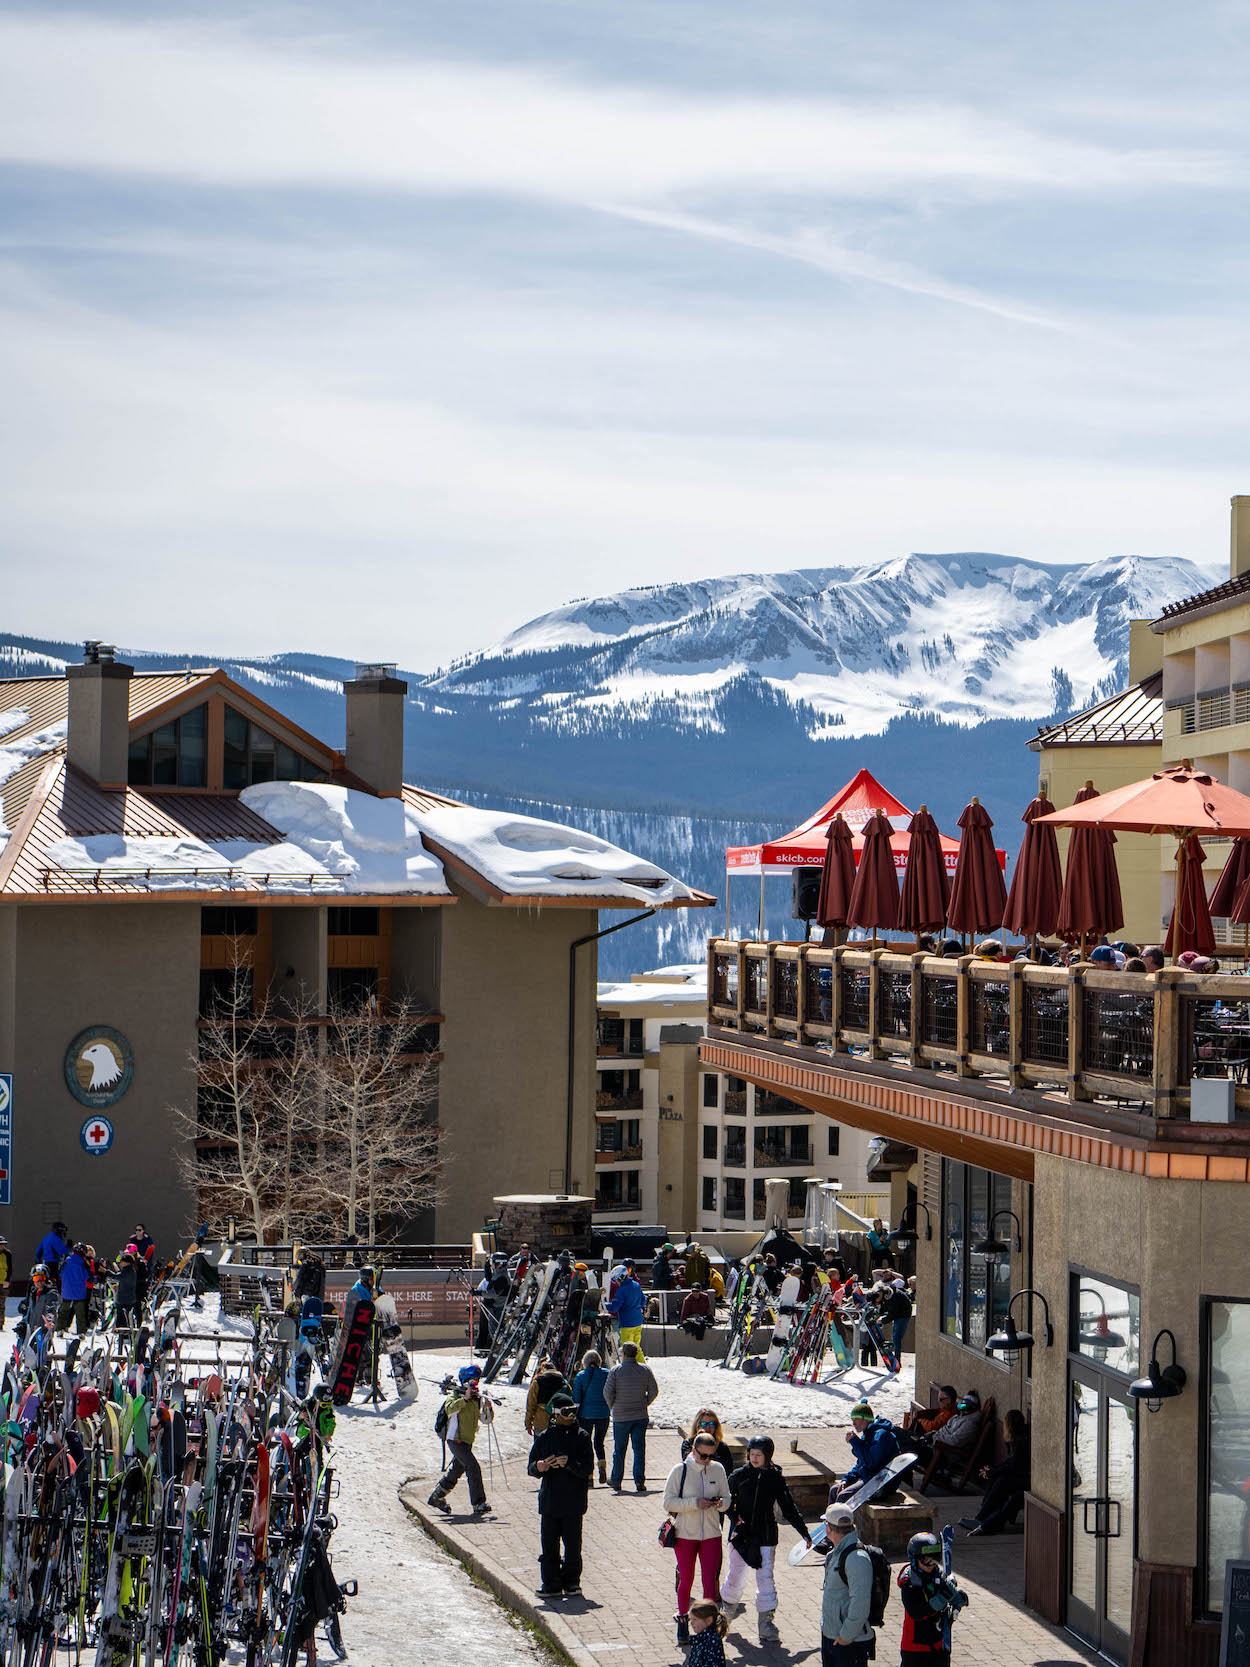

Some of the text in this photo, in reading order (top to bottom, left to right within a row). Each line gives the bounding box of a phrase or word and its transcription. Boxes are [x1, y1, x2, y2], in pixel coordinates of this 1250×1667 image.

[659, 1107, 683, 1120] PLAZA
[445, 1291, 470, 1302] STAY
[335, 1308, 371, 1397] NICHE
